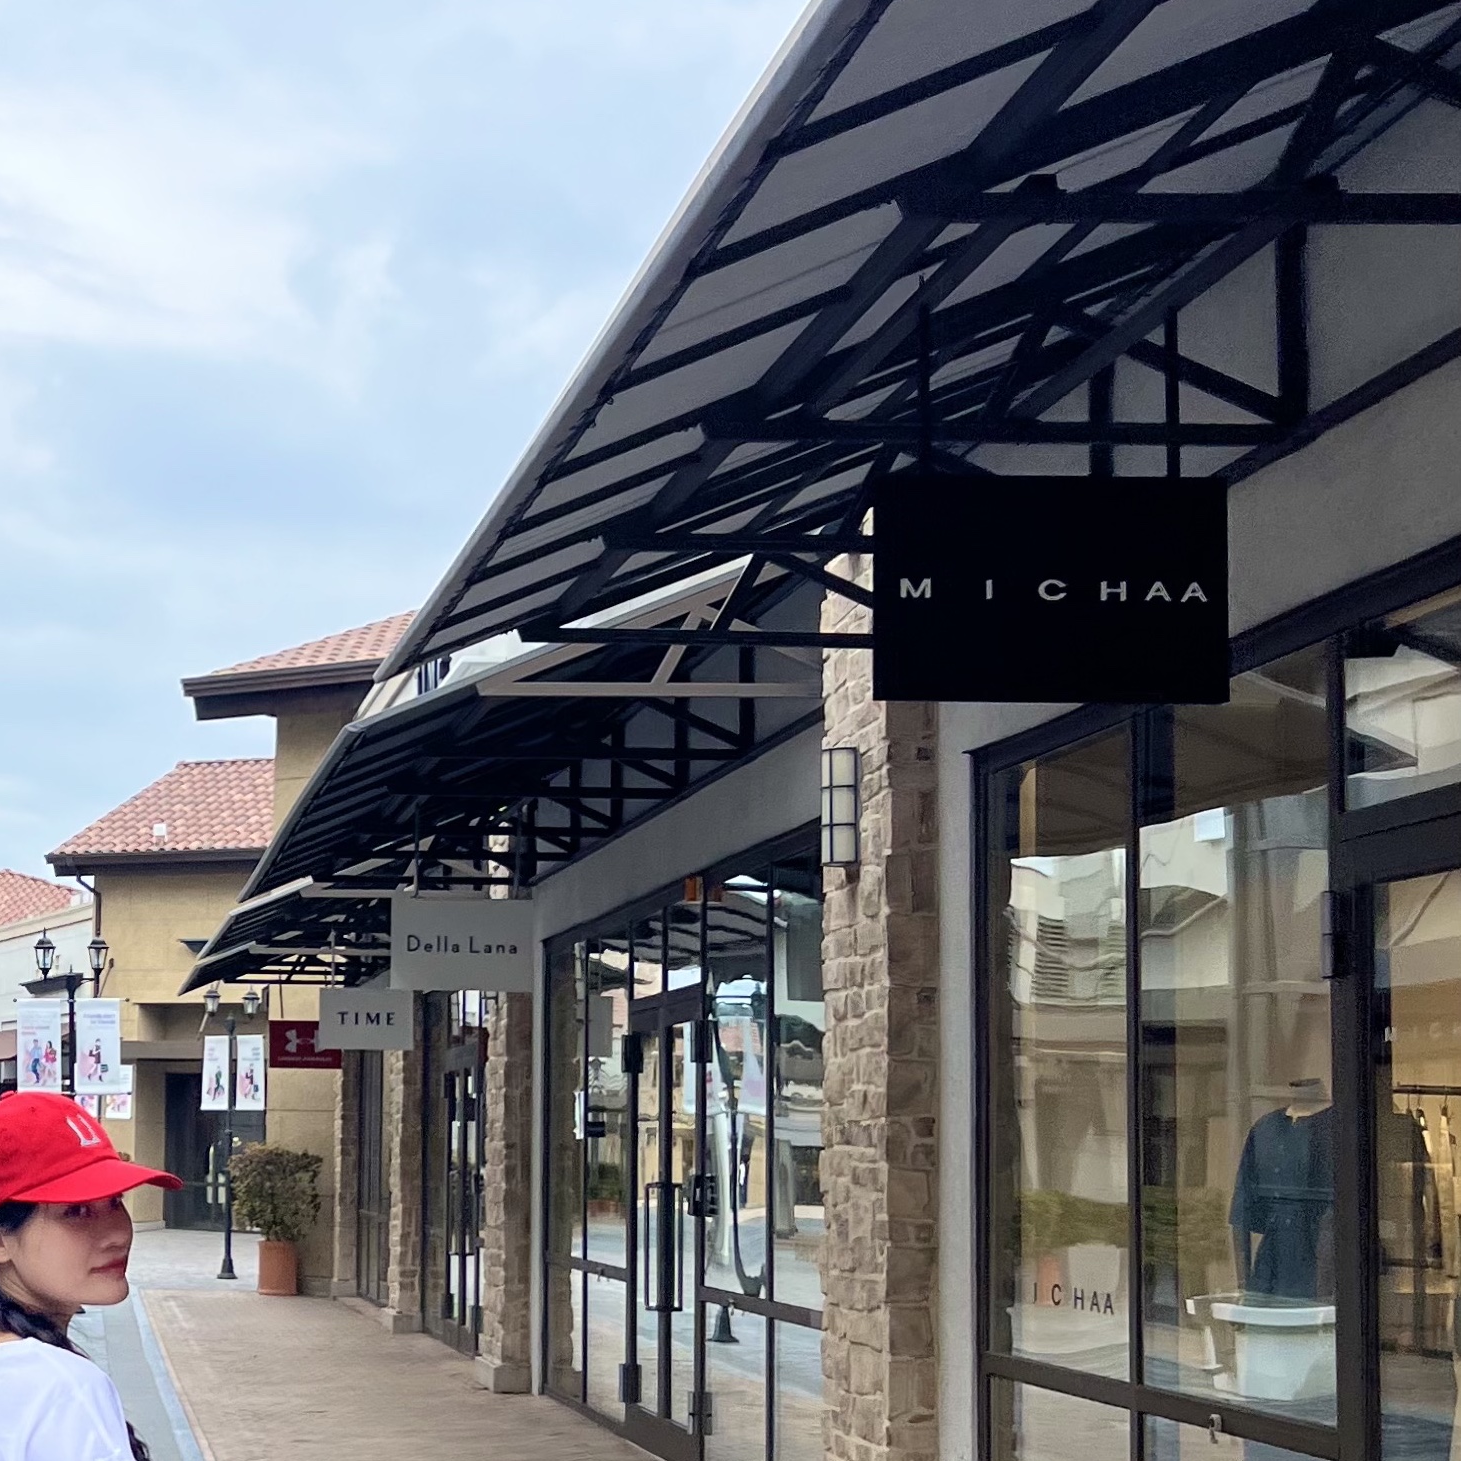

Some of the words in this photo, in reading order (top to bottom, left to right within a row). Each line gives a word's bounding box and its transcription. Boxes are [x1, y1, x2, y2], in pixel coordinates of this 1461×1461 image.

[899, 577, 1208, 604] MICHAA
[406, 934, 460, 954] Della
[468, 935, 519, 955] Lana
[336, 1011, 396, 1026] TIME
